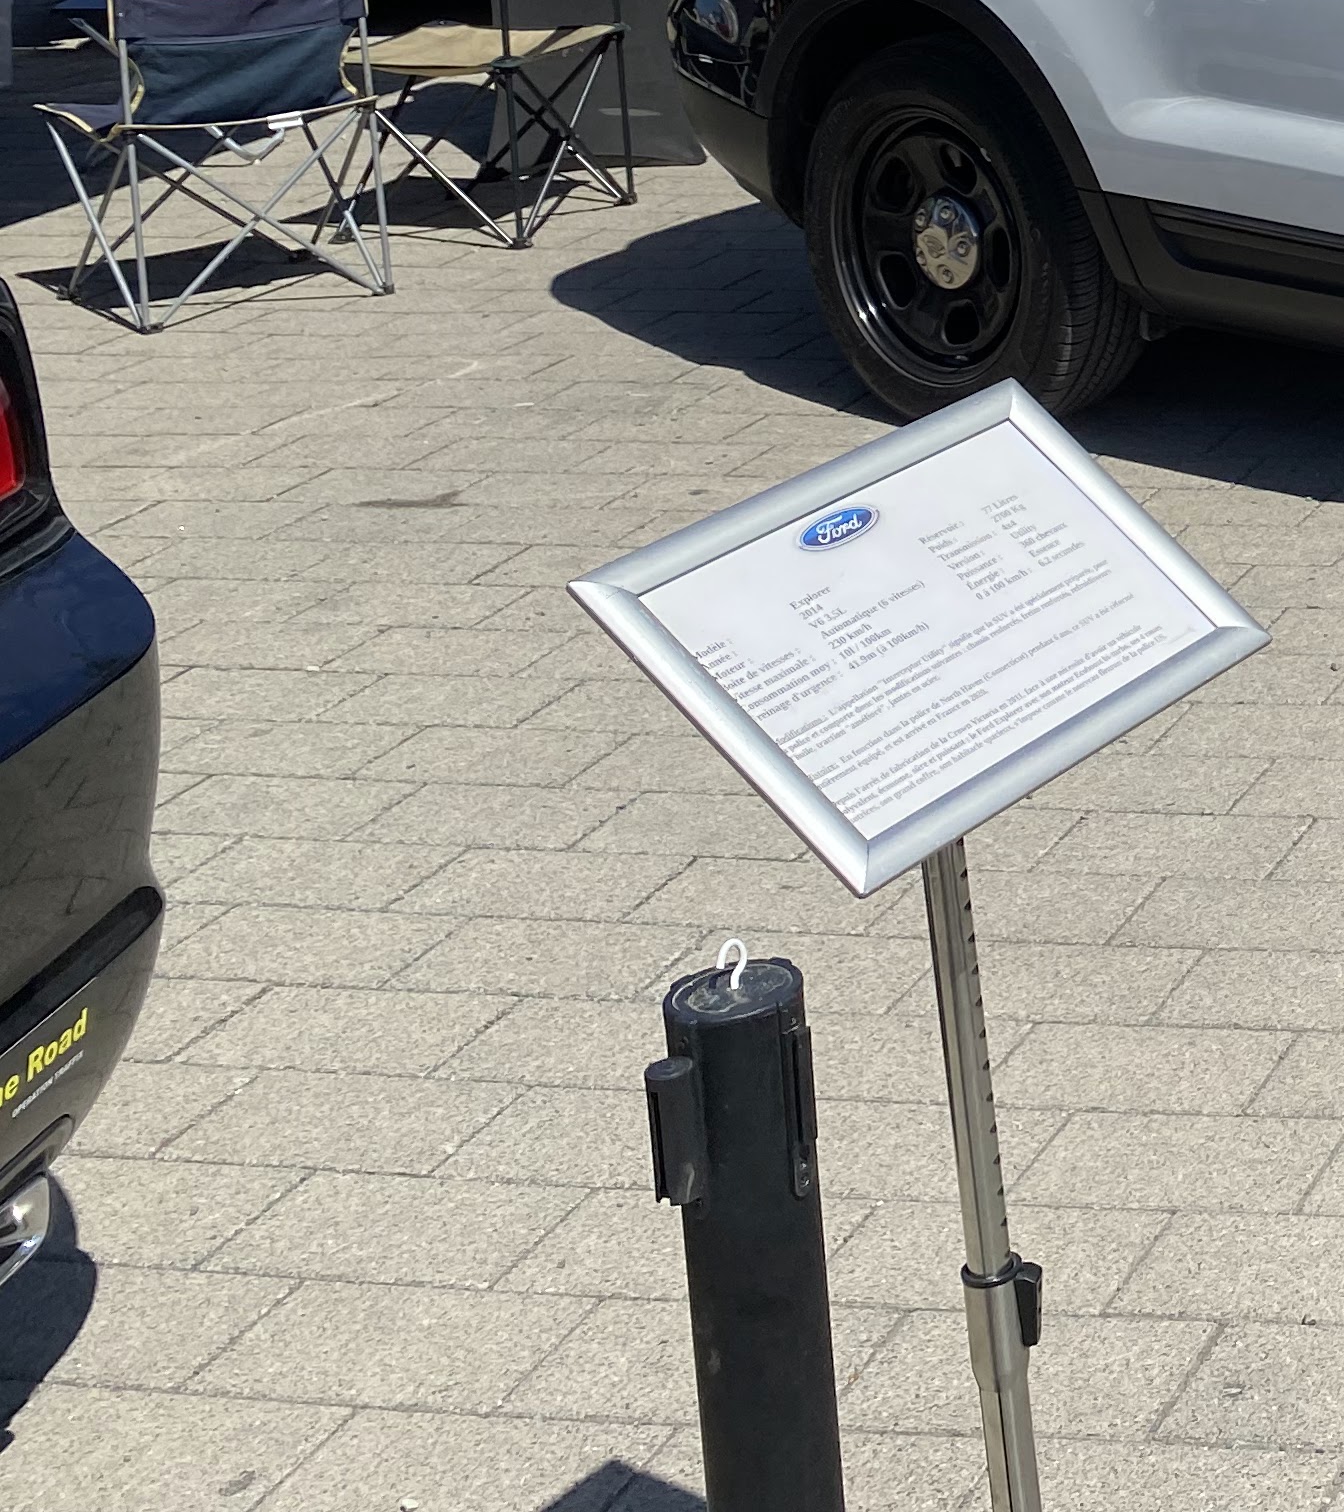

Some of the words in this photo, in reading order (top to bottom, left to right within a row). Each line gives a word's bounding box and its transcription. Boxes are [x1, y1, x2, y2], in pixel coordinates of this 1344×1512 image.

[816, 513, 862, 544] Ford
[957, 557, 998, 580] Puissance
[790, 586, 831, 610] Explorer
[821, 605, 878, 639] Automatique
[889, 580, 926, 601] vitesses)
[800, 603, 824, 620] 2014
[808, 616, 826, 628] V6
[828, 635, 848, 649] 230
[846, 623, 873, 640] km/h
[860, 628, 892, 647] 100km
[887, 621, 930, 647] 100km/h)
[746, 670, 759, 680] de
[759, 651, 795, 672] vitesses
[764, 658, 809, 686] maximale
[757, 699, 792, 721] reinage
[792, 674, 836, 702] d'urgence
[27, 1007, 88, 1082] Road
